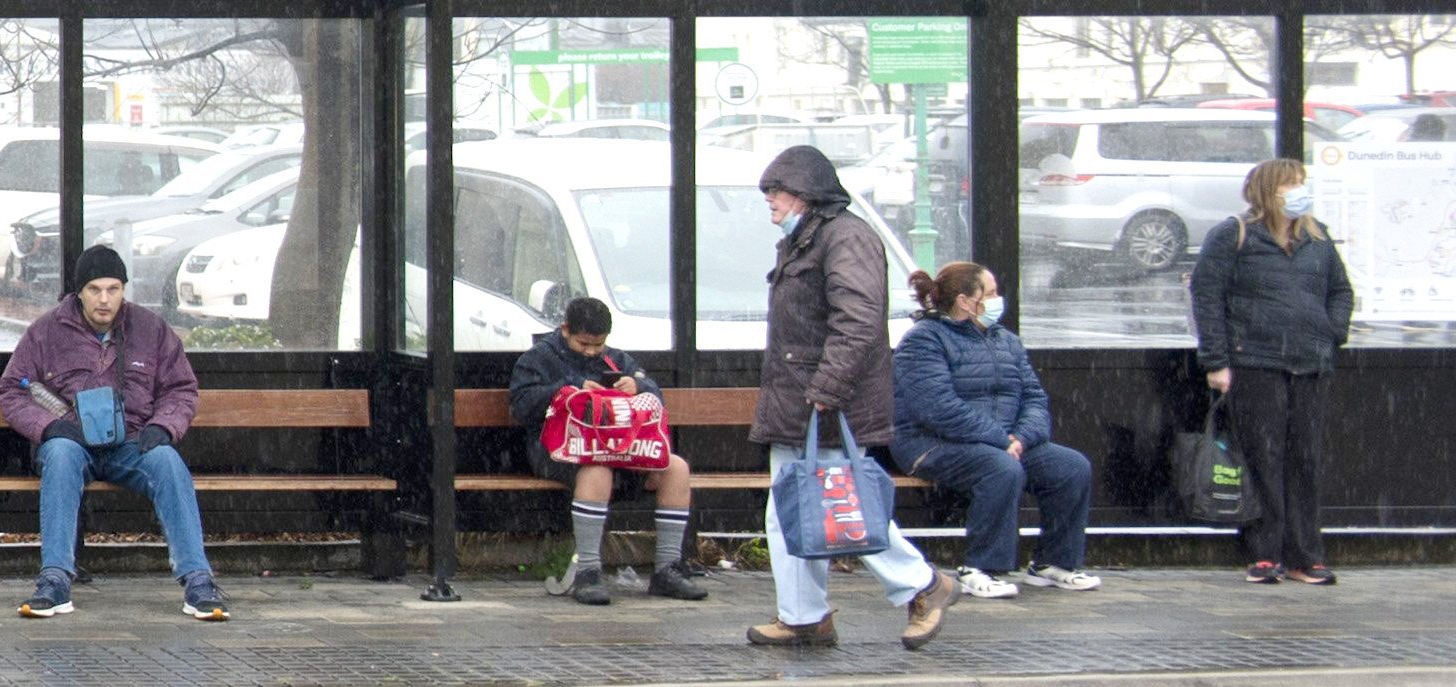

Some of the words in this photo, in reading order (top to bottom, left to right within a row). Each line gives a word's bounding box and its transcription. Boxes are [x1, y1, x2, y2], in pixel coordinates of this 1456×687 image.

[871, 22, 915, 32] Customer
[917, 22, 952, 33] Parking
[558, 52, 587, 63] please
[588, 53, 617, 61] return
[618, 53, 639, 63] your
[1347, 151, 1394, 161] Dunedin
[1396, 151, 1417, 161] Bus
[1419, 151, 1443, 161] Hub
[568, 437, 663, 459] BILLAONG
[1213, 464, 1236, 477] Bag
